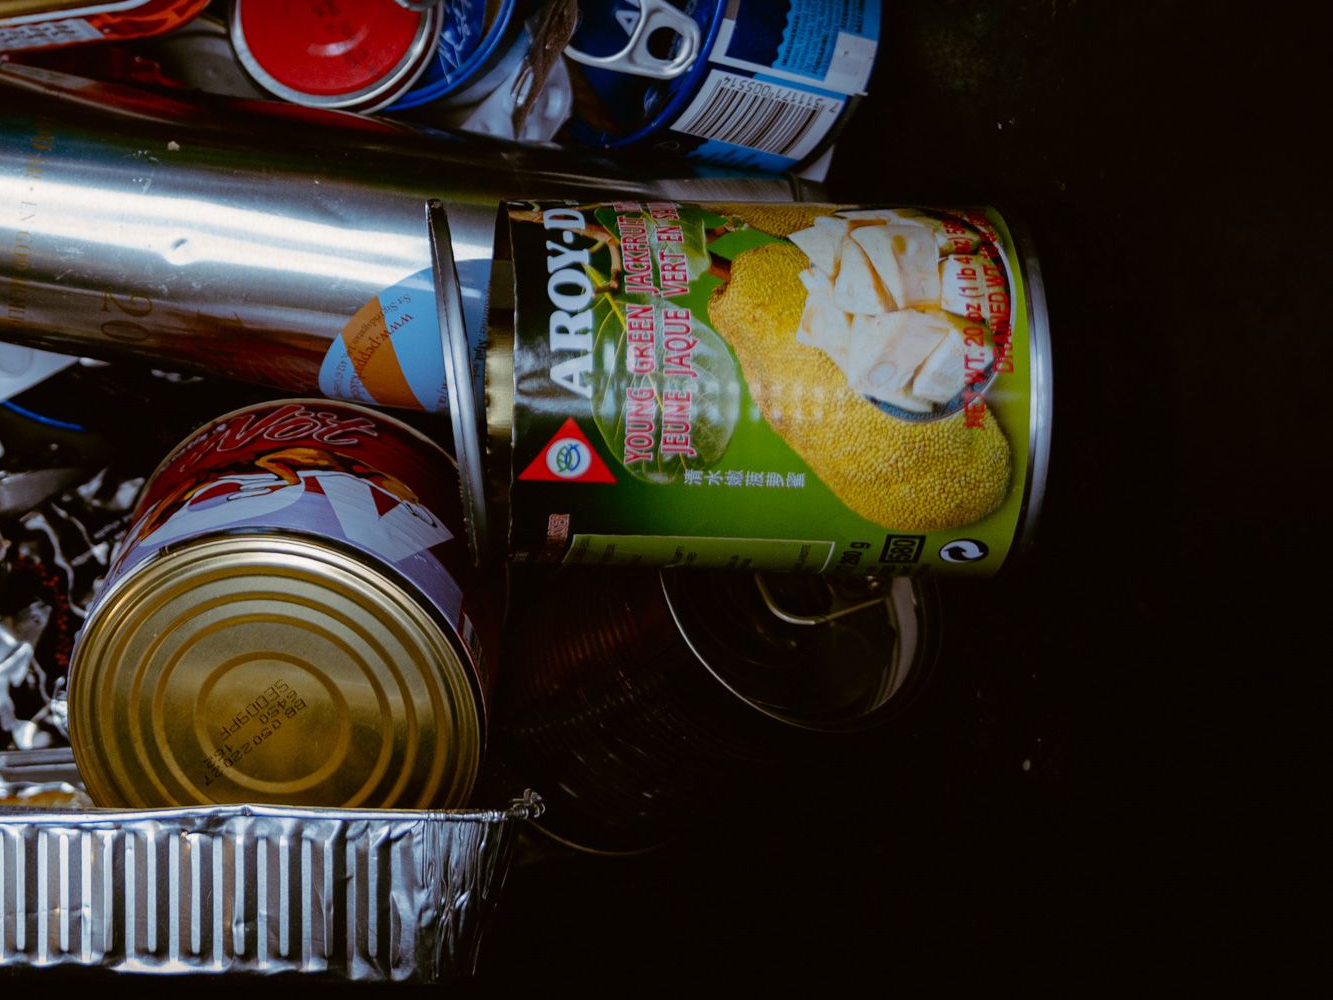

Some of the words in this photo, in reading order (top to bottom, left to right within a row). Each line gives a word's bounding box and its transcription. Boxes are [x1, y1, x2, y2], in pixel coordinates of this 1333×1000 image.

[721, 76, 771, 97] 005514
[618, 214, 659, 297] JACKFRUIT
[657, 223, 685, 245] EN
[659, 251, 691, 298] VERT
[956, 266, 977, 281] lb
[547, 200, 595, 399] AROY-D
[966, 303, 982, 324] oz
[626, 303, 656, 376] GREEN
[663, 307, 699, 379] JAQUE
[964, 324, 985, 347] 20
[987, 292, 1014, 374] DRAINED
[964, 352, 985, 386] WT.
[623, 387, 656, 466] YOUNG
[661, 392, 698, 457] JEUNE
[283, 698, 306, 719] BB
